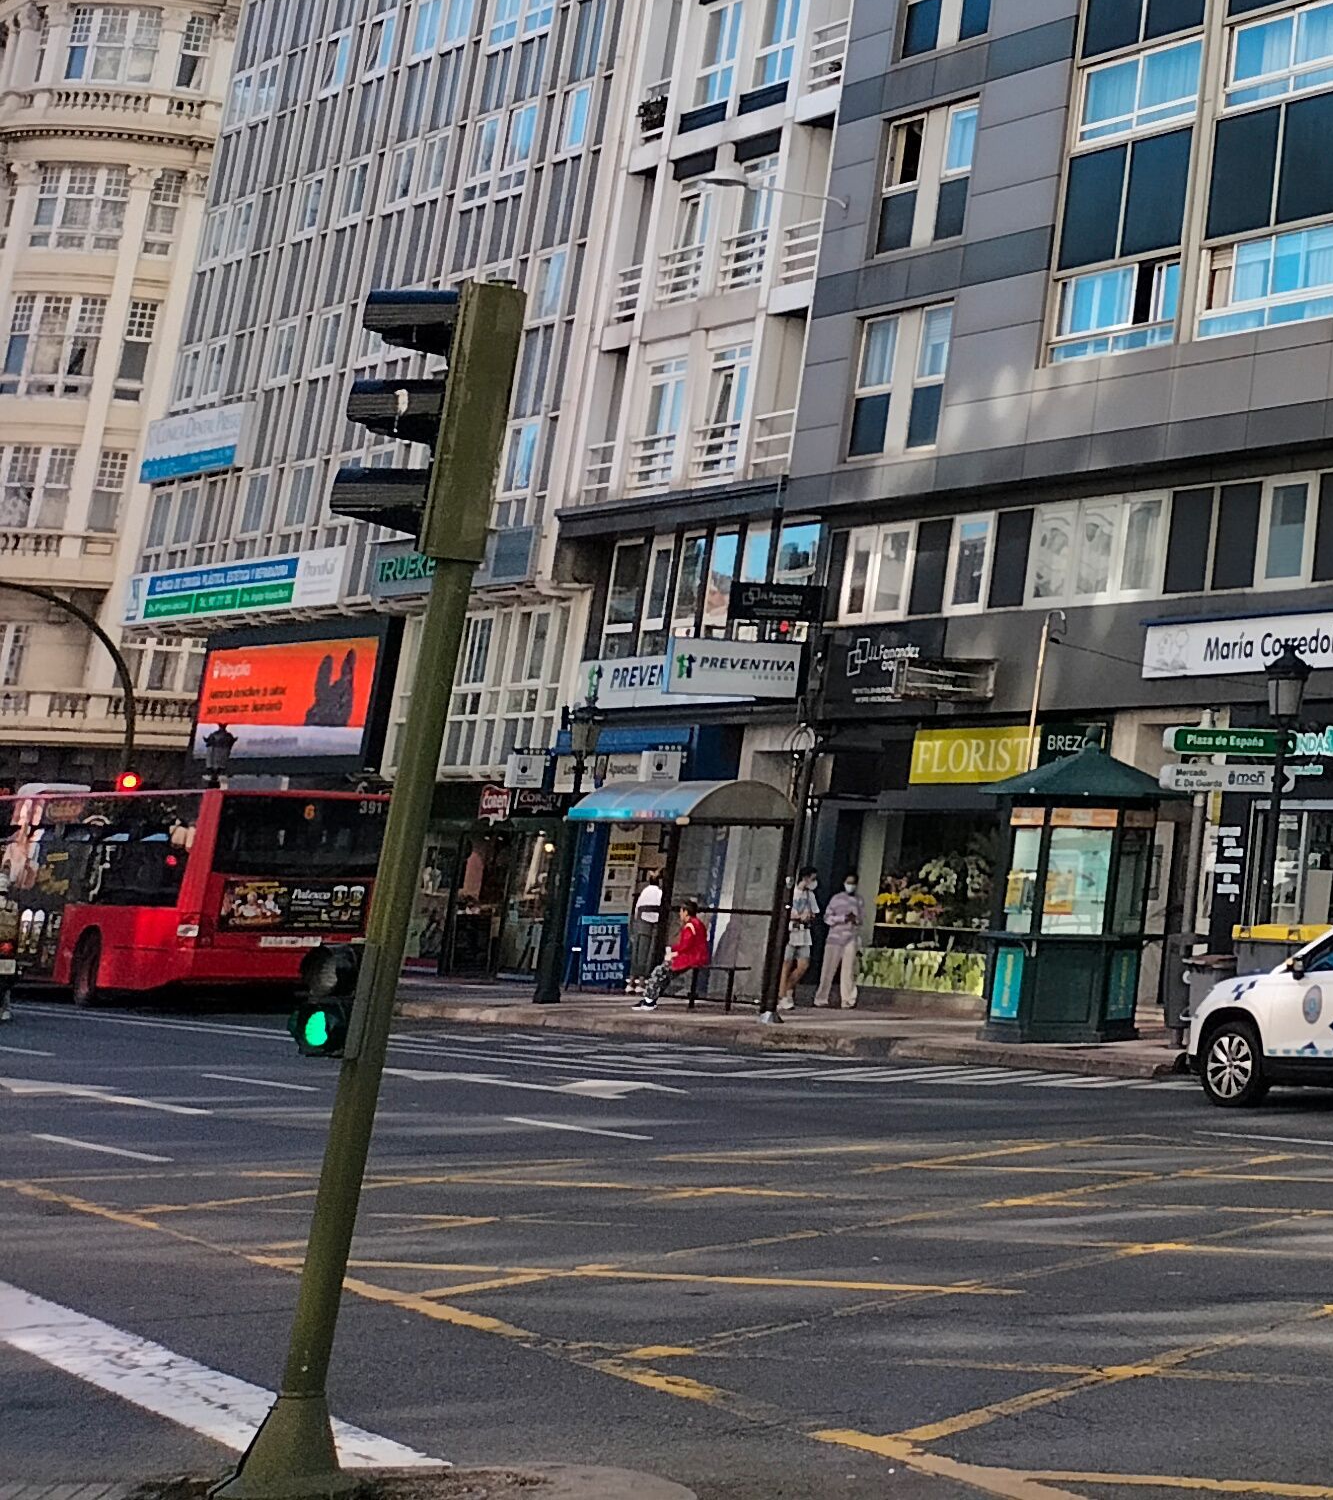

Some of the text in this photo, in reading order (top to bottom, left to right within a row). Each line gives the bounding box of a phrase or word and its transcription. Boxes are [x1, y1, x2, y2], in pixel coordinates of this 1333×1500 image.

[1203, 633, 1254, 661] María
[700, 656, 796, 672] PREVENTIVA
[610, 664, 664, 688] PREVEN
[1186, 734, 1264, 749] Plaza de España
[1176, 768, 1207, 777] Mercado
[1184, 779, 1194, 787] Da
[1196, 779, 1222, 788] Guarda
[359, 801, 383, 814] 391
[588, 925, 621, 935] BOTE
